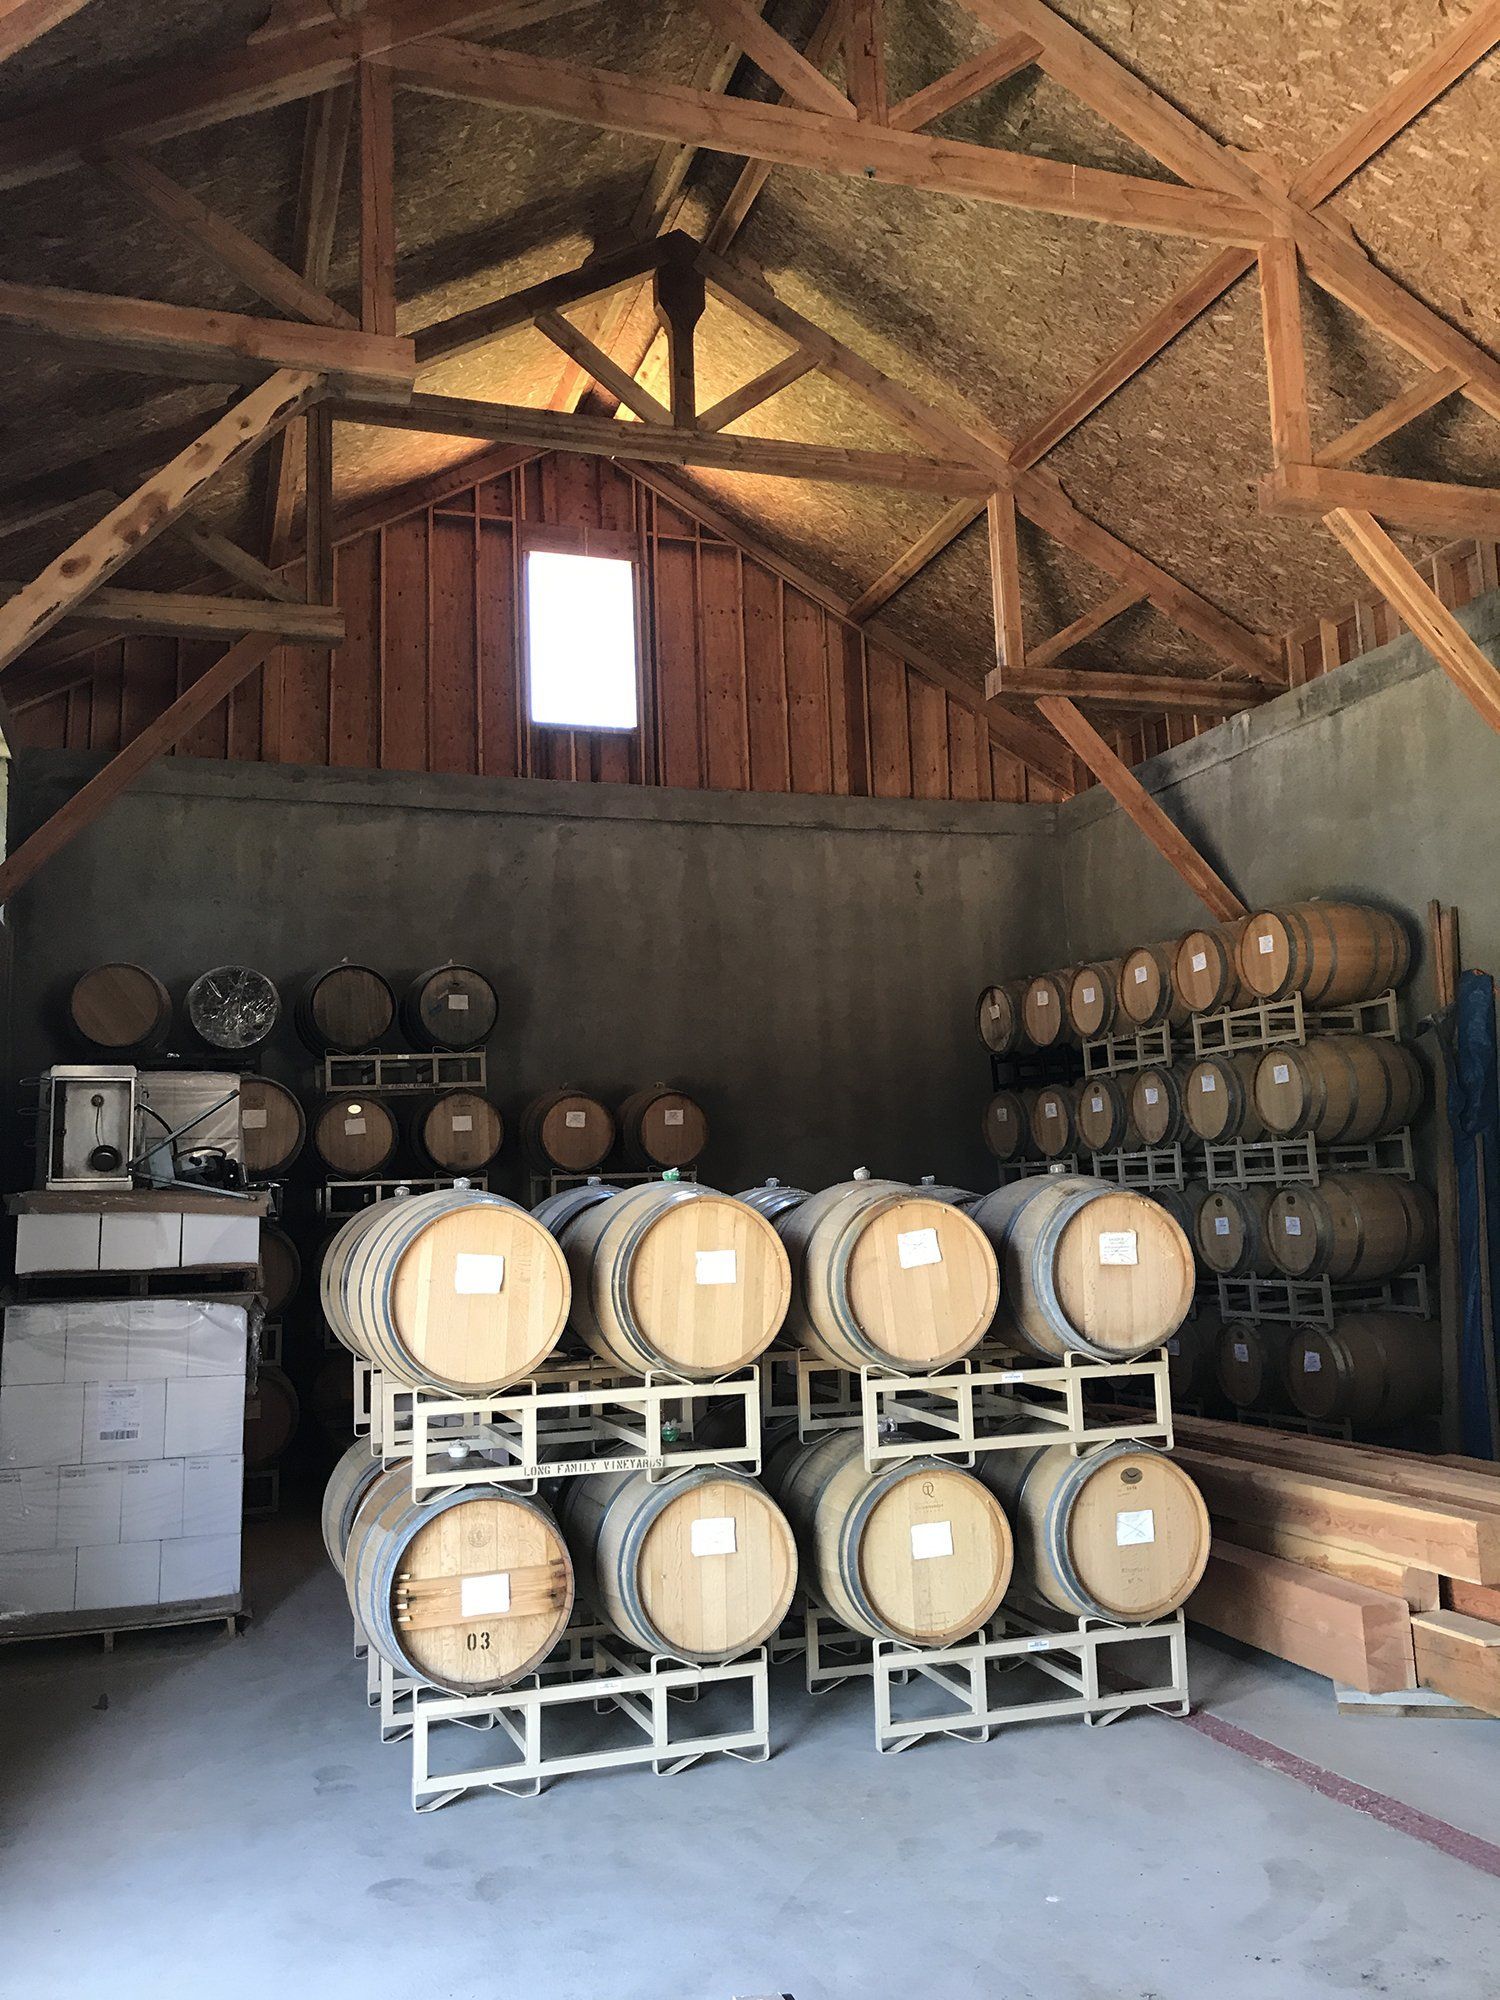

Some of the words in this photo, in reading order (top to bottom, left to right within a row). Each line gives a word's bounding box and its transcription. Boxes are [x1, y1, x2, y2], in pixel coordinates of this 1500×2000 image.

[524, 1465, 551, 1477] LONG
[557, 1461, 597, 1475] FAMILY
[467, 1631, 490, 1651] 03
